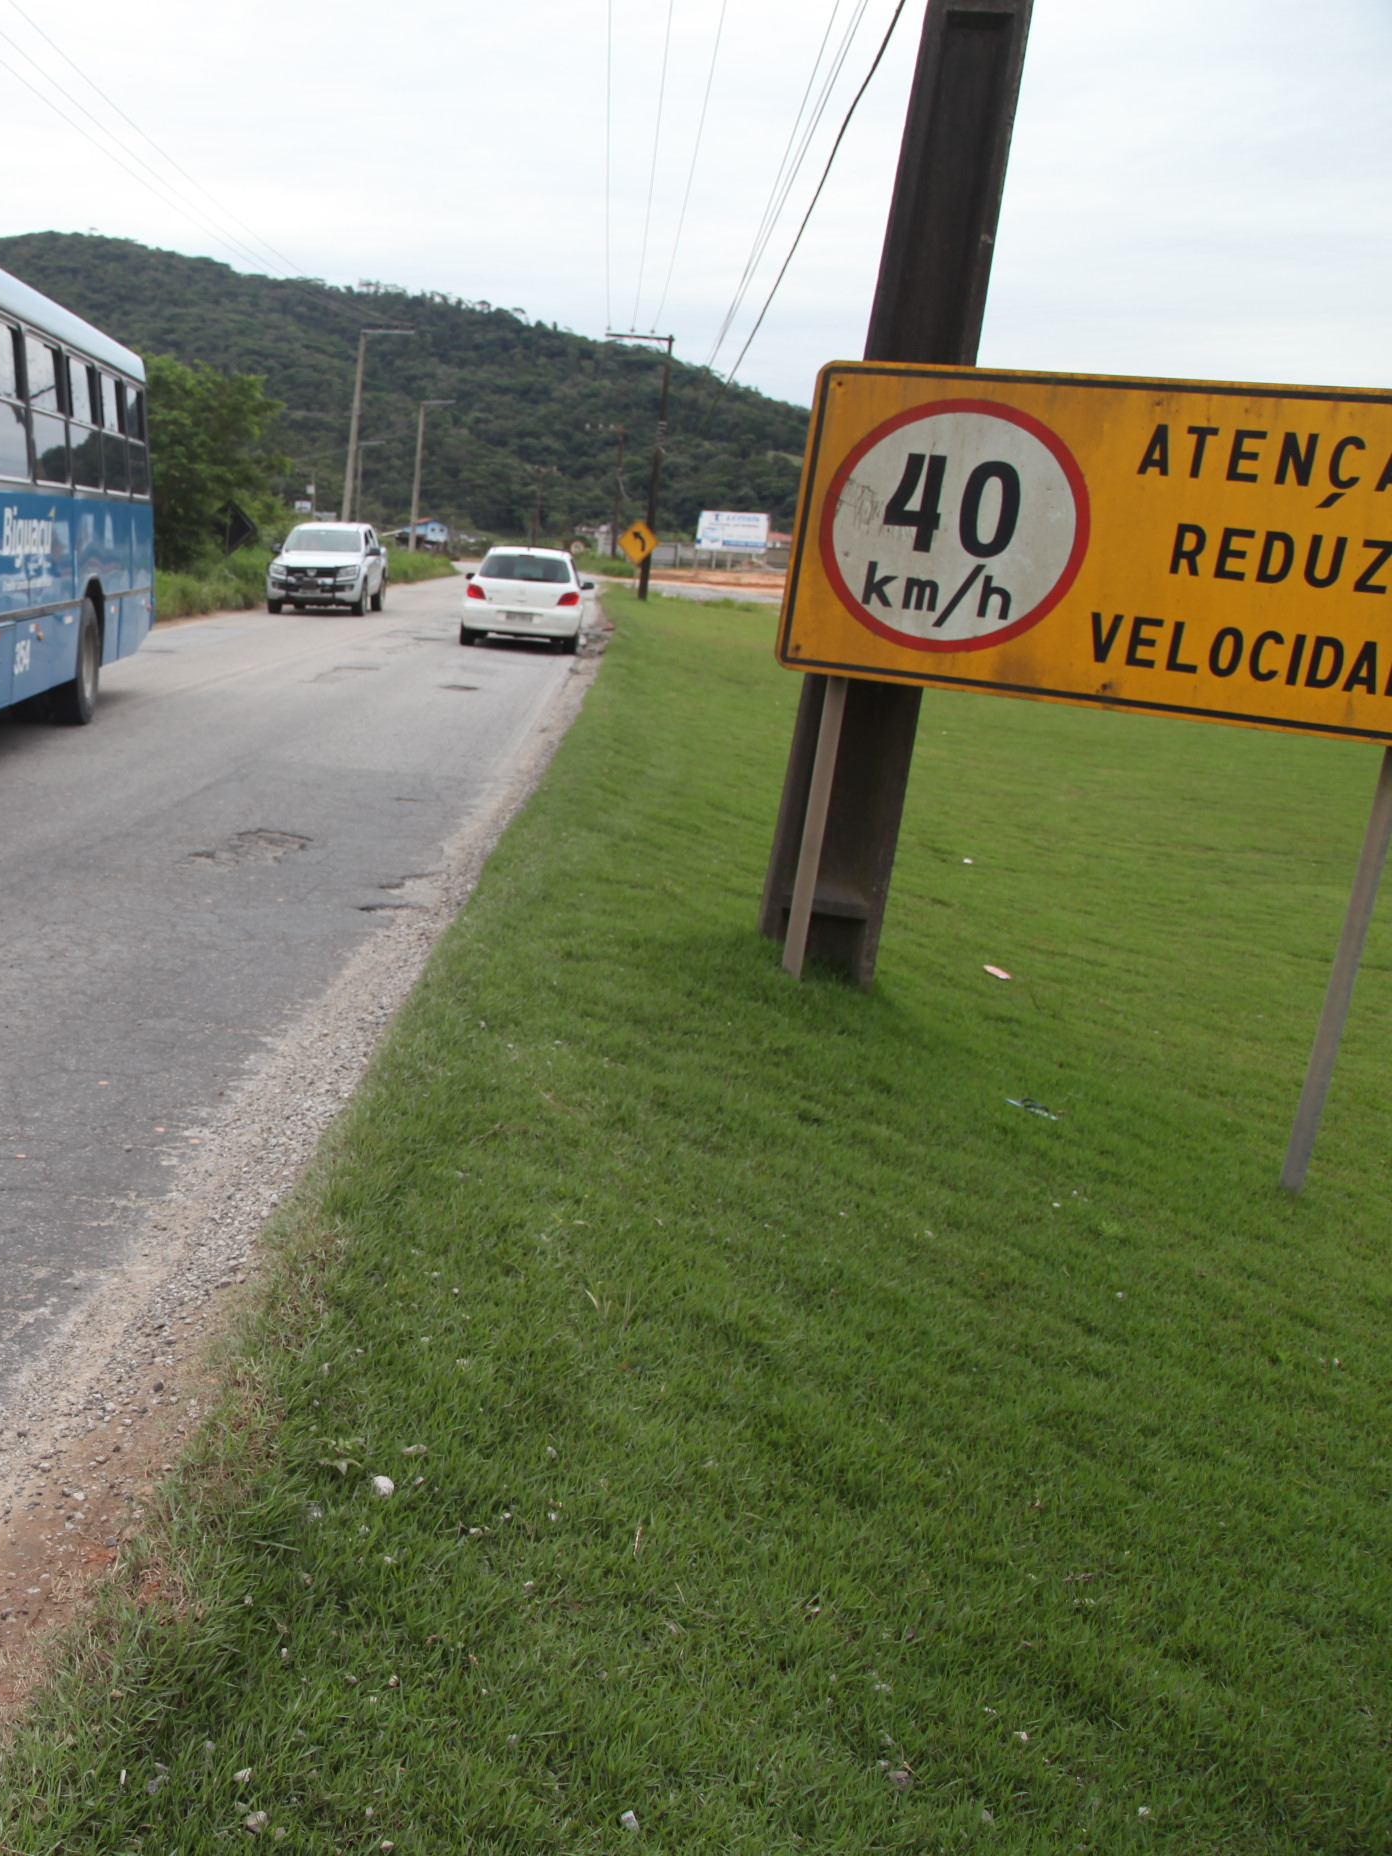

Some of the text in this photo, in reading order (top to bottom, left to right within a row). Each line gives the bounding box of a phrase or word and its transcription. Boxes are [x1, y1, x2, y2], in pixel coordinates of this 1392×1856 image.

[883, 453, 1021, 558] 40
[861, 561, 1012, 627] km/h
[1169, 523, 1392, 594] REDUZ
[1091, 612, 1392, 697] VELOCIDA
